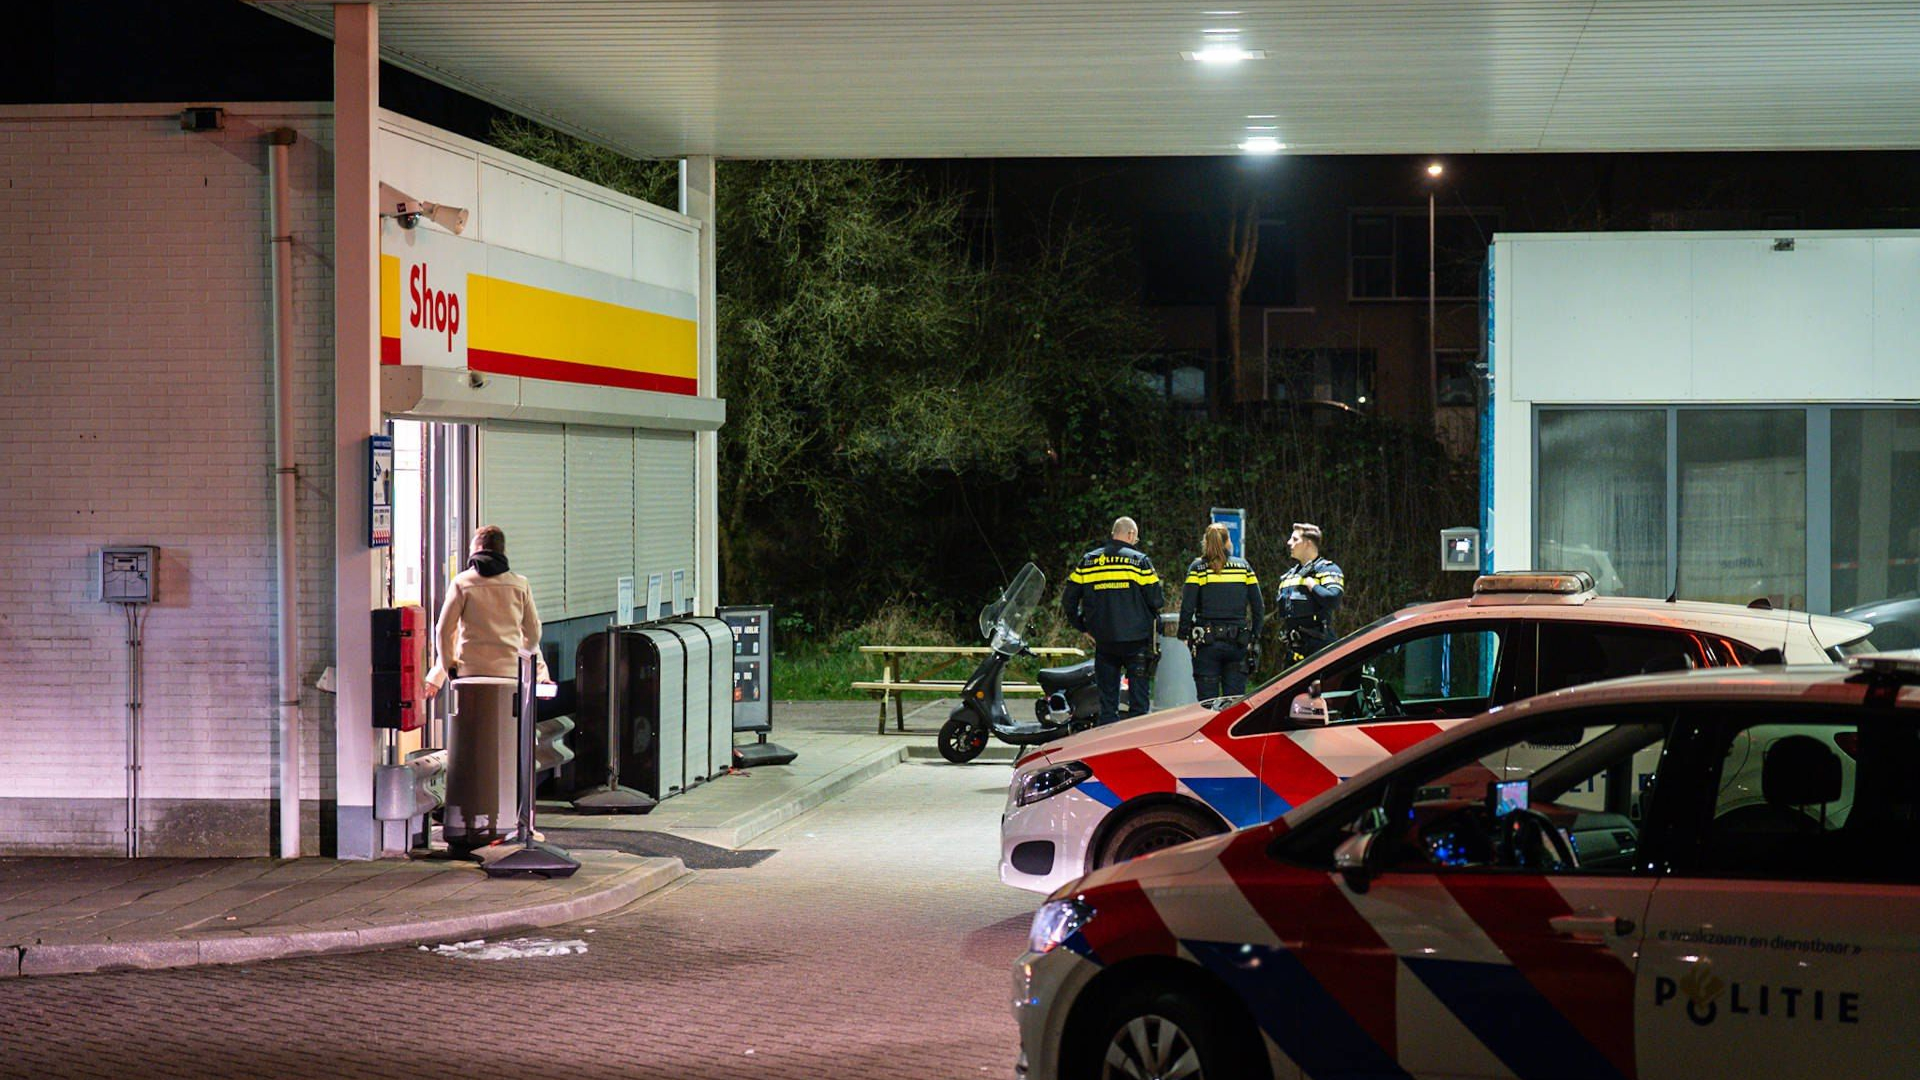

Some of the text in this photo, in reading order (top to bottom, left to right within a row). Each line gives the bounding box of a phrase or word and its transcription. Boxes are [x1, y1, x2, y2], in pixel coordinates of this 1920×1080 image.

[409, 262, 460, 352] Shop
[1094, 554, 1130, 566] POLITIE
[1670, 927, 1747, 946] waakzaam
[1750, 936, 1769, 947] en
[1770, 935, 1850, 954] dienstbaar
[1655, 975, 1860, 1026] POLITIE
